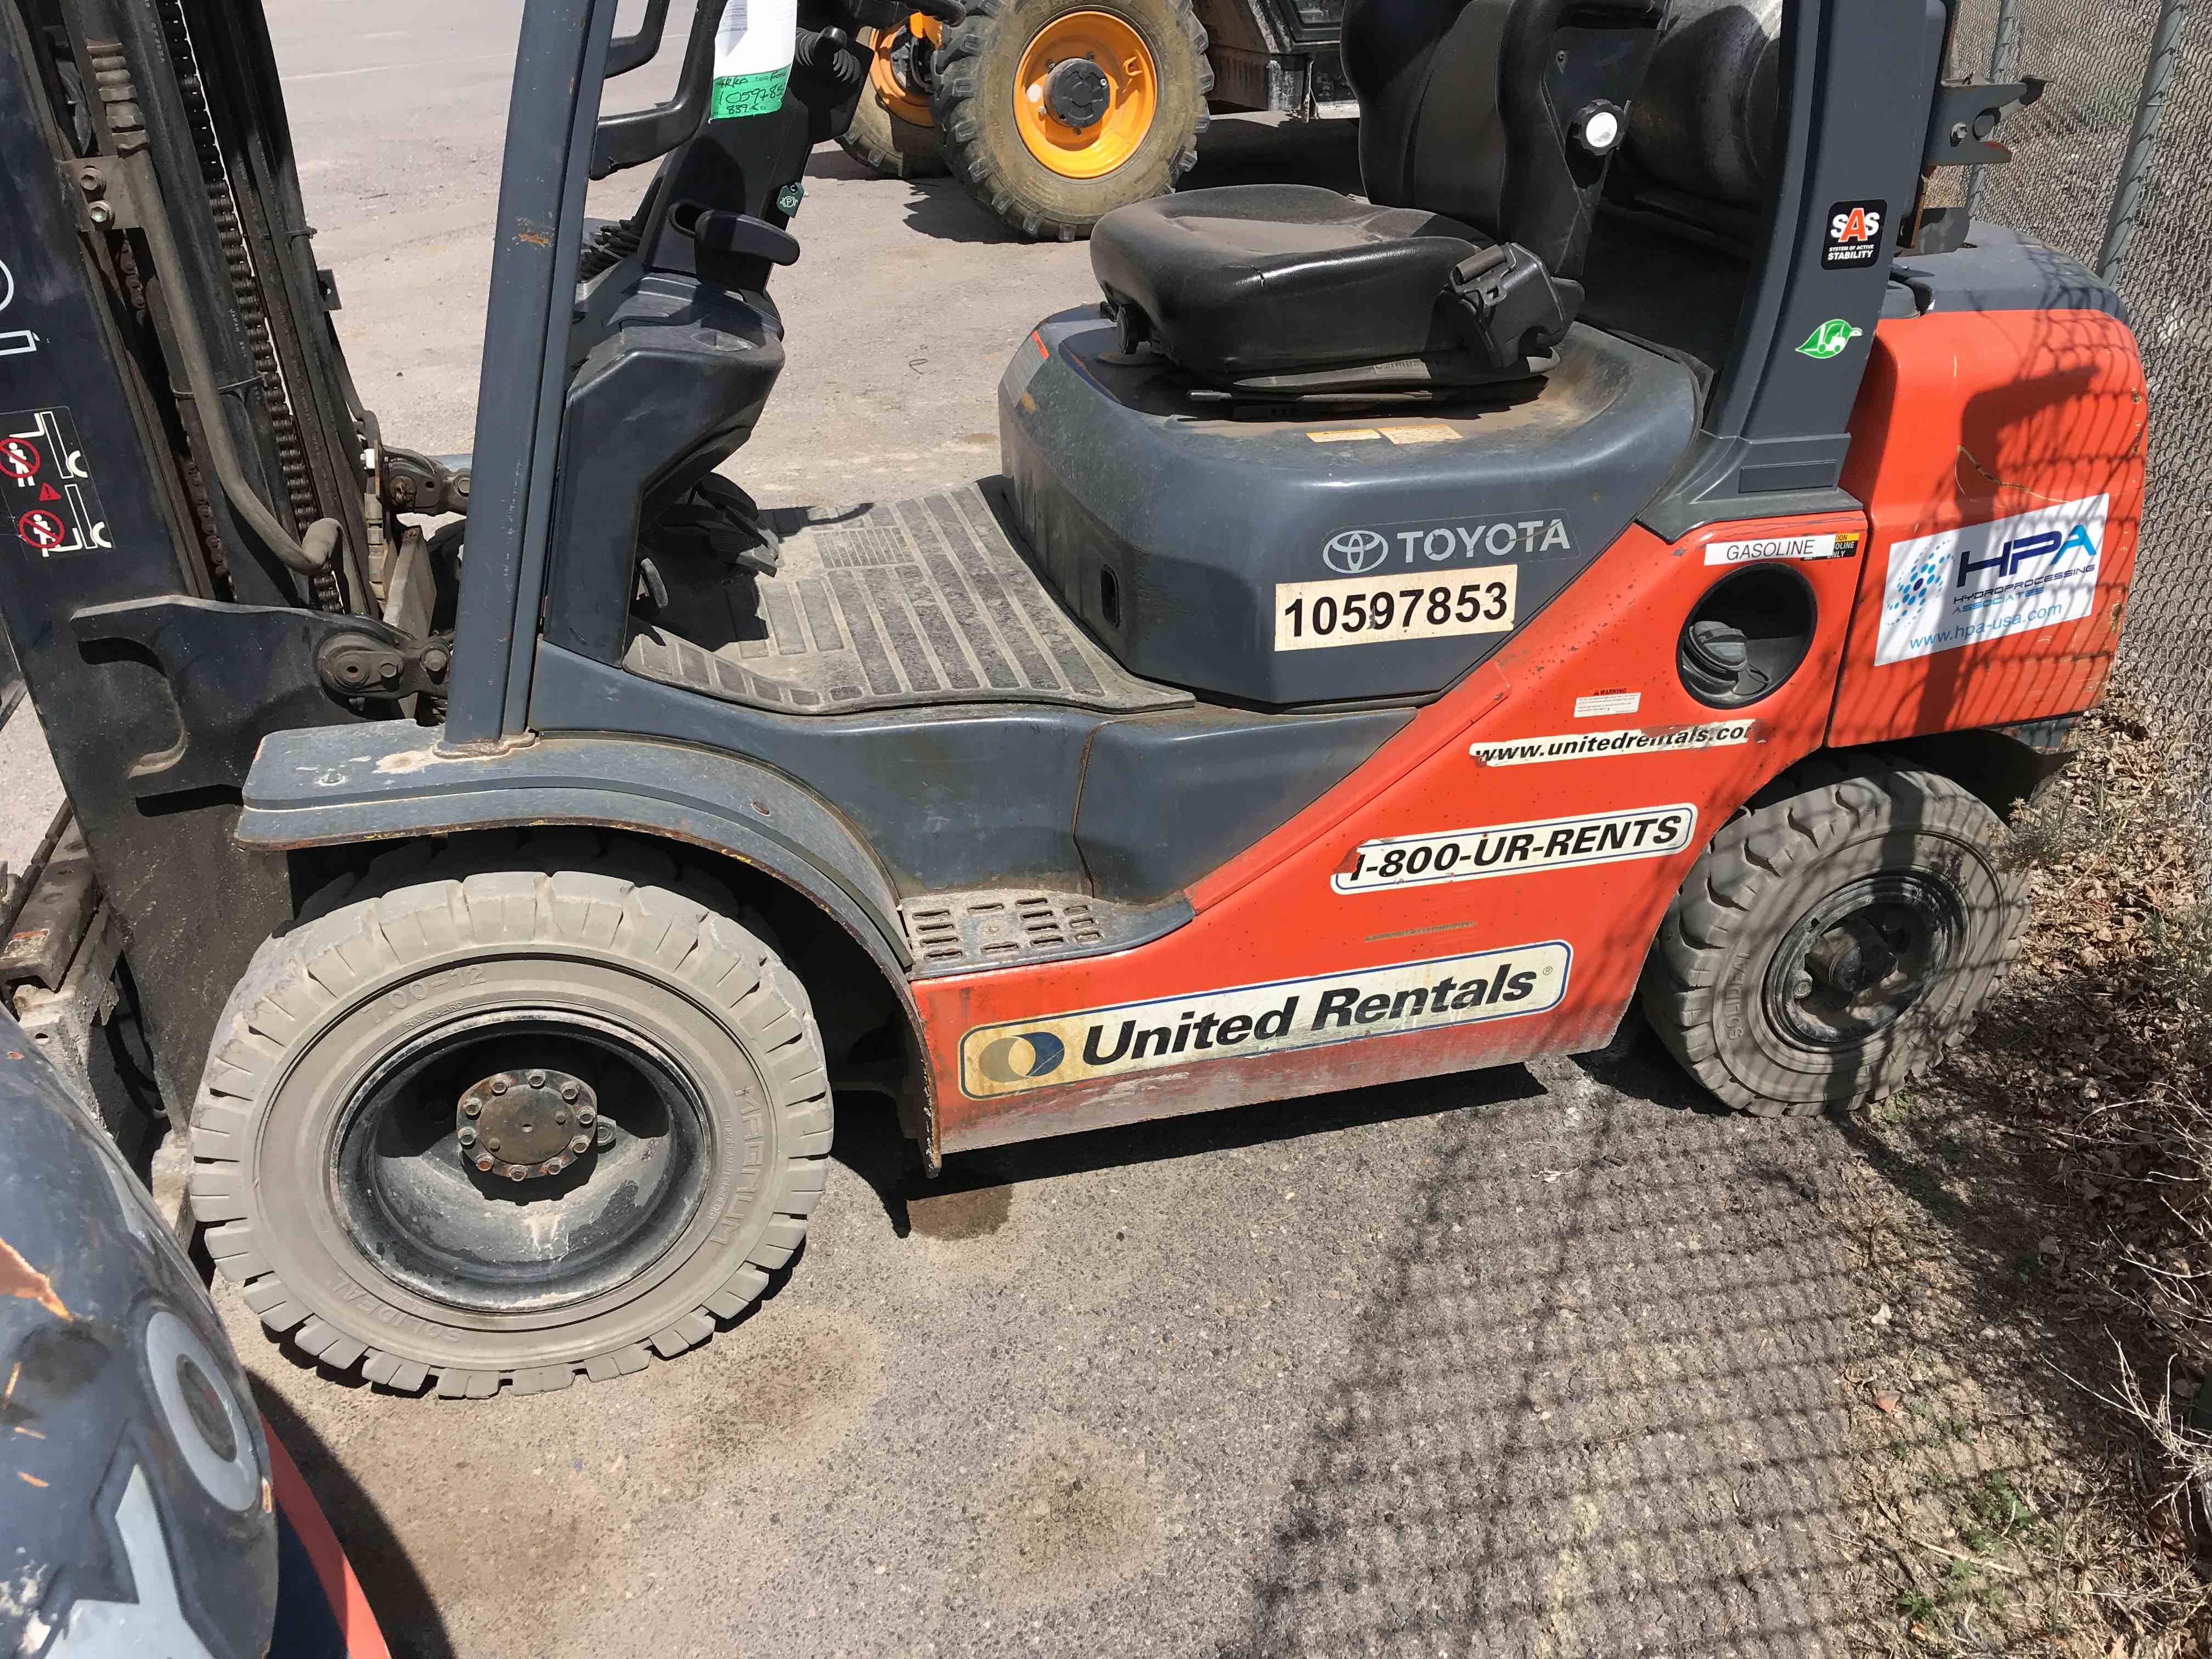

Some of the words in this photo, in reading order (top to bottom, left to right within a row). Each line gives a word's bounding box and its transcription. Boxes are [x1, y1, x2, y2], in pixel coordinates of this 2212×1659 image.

[1830, 207, 1880, 242] SAS
[1827, 250, 1874, 261] STABILITY
[1397, 518, 1571, 563] TOYOTA
[1726, 539, 1815, 561] GASOLINE
[1956, 523, 2098, 588] HPA
[1952, 586, 2045, 614] ASSOCIATES
[1953, 564, 2096, 605] HYDROPROCESSING
[1284, 582, 1507, 637] 10597853
[1909, 603, 2062, 650] www.hpa-usa.com
[1600, 687, 1627, 696] WARNING
[1350, 815, 1683, 882] 1-800-UR-RENTS
[360, 964, 488, 1027] 7.00-12
[427, 1001, 465, 1019] GUARD
[1082, 995, 1300, 1067] United
[1311, 963, 1538, 1032] Rentals
